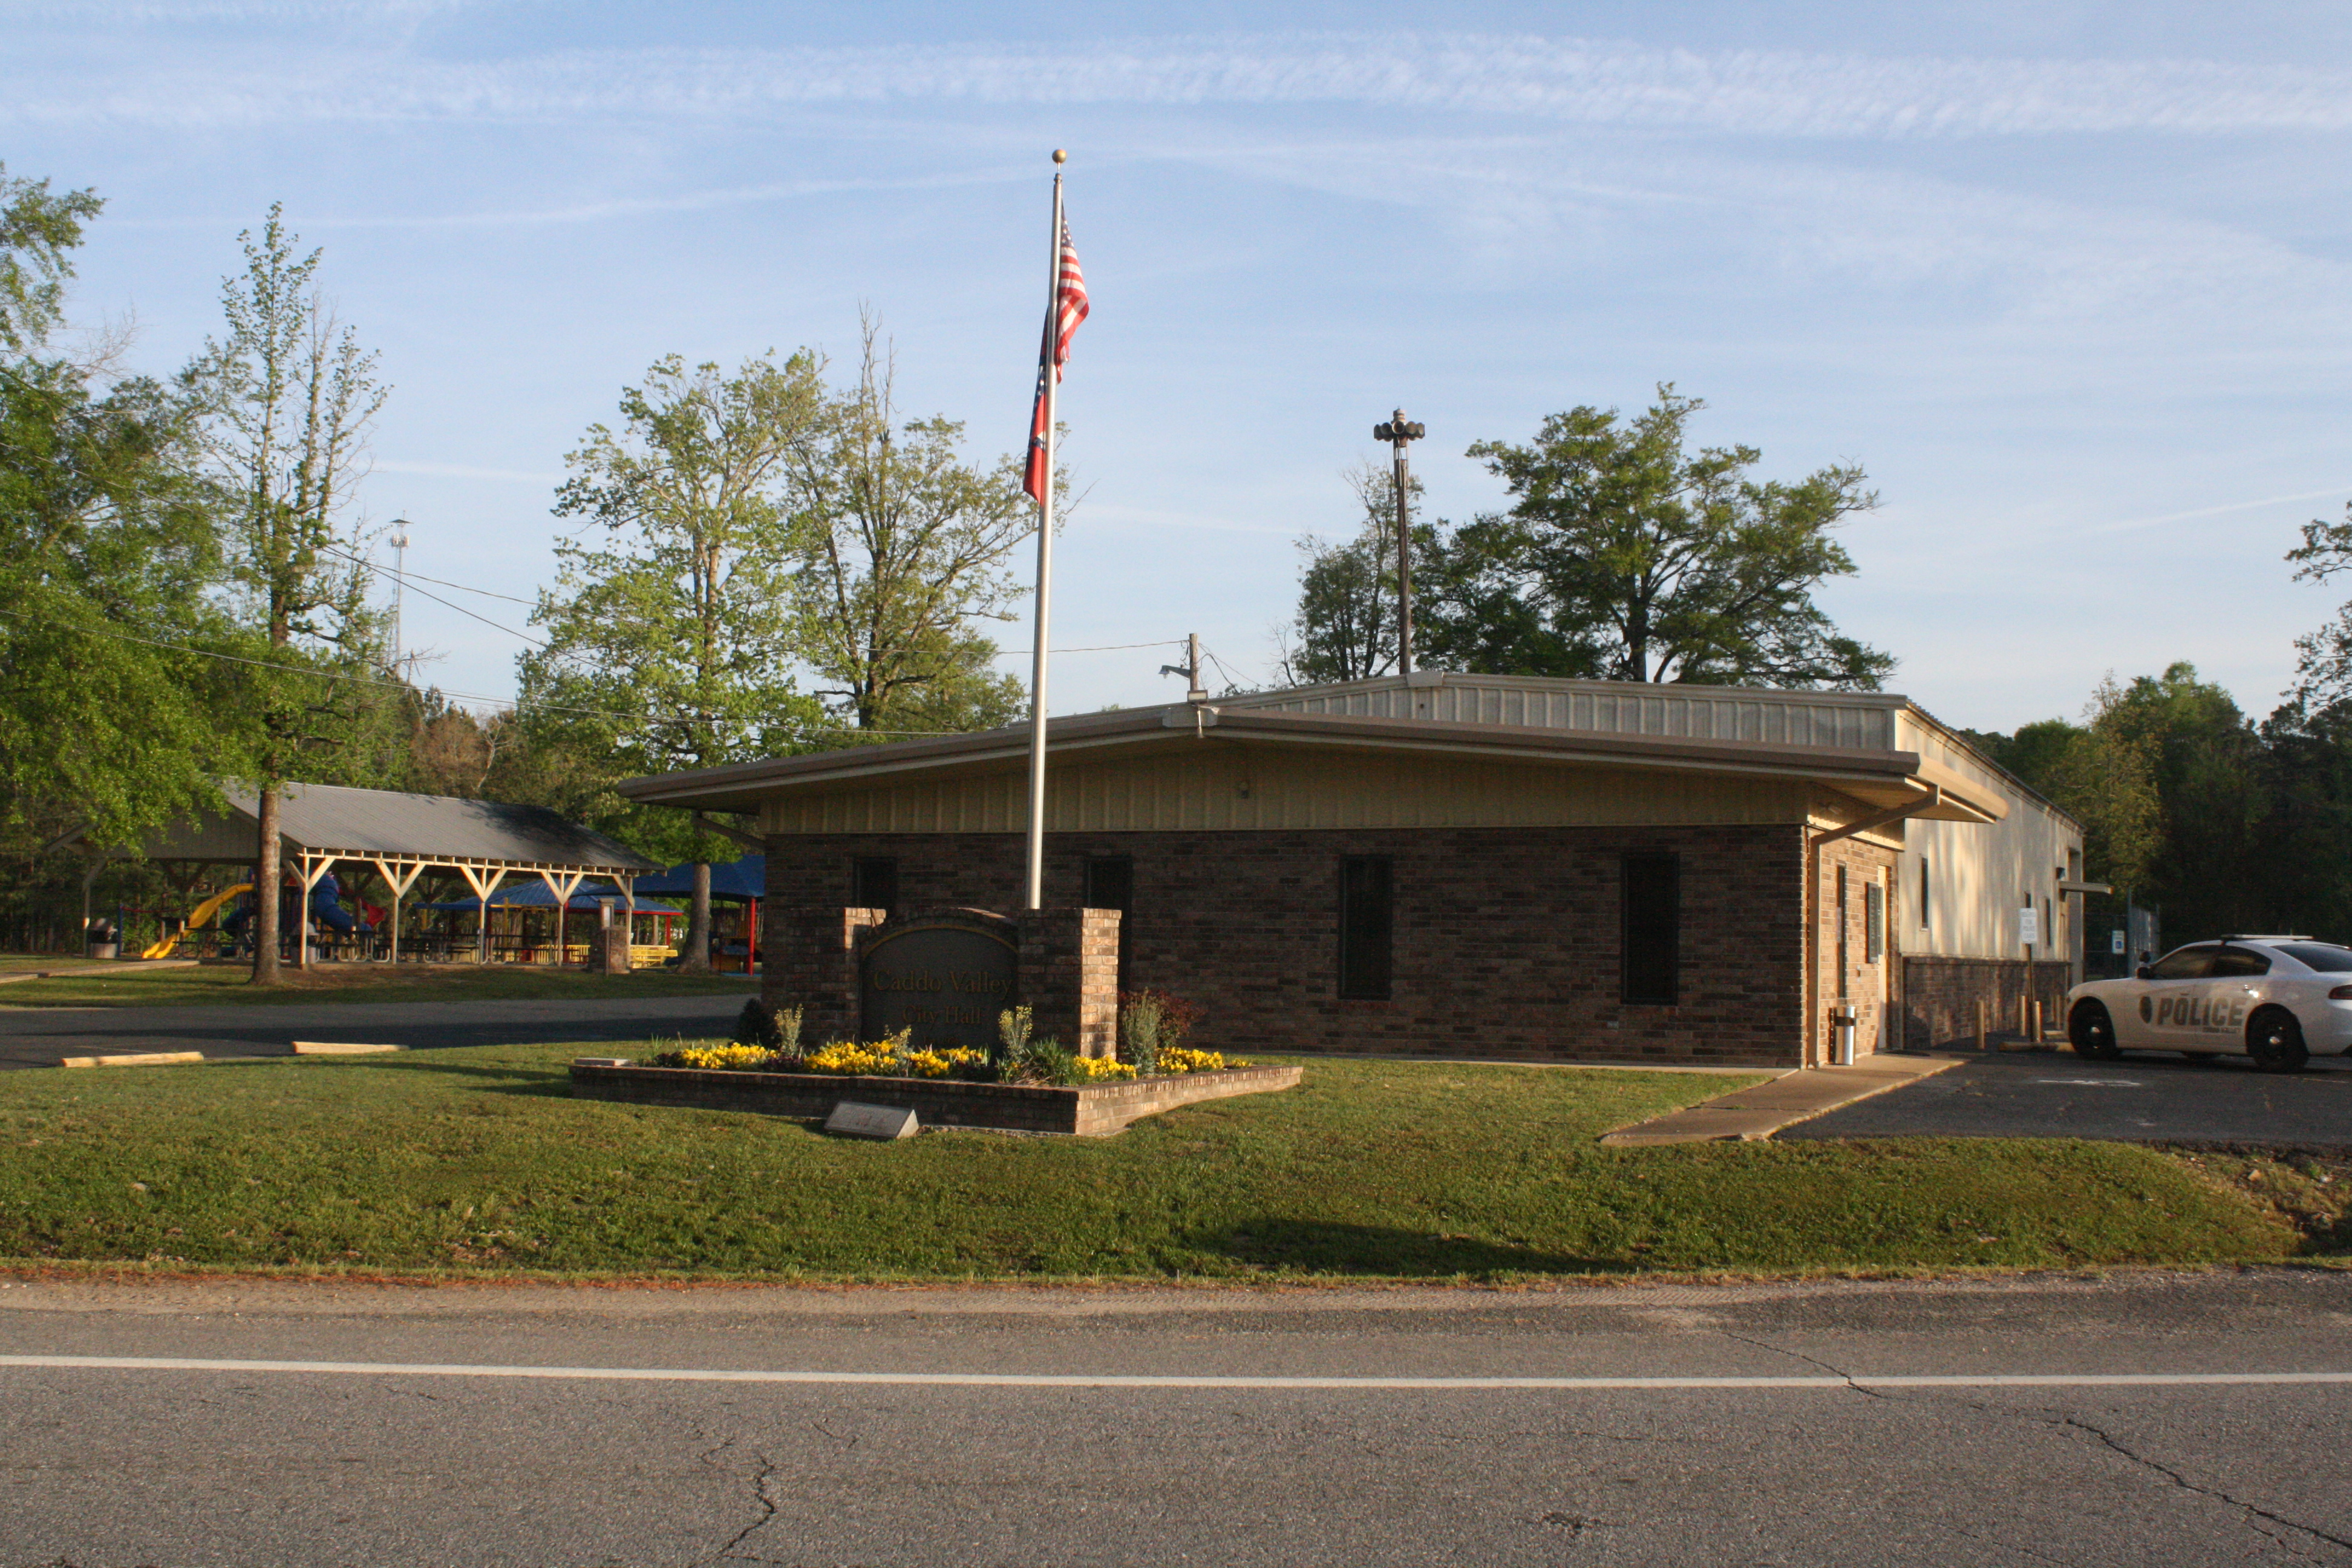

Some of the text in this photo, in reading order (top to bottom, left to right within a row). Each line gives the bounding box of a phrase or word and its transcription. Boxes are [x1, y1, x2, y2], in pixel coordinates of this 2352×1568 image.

[874, 970, 1013, 1000] Caddo Valley
[903, 1005, 981, 1030] City Hall
[2158, 998, 2247, 1027] POLICE
